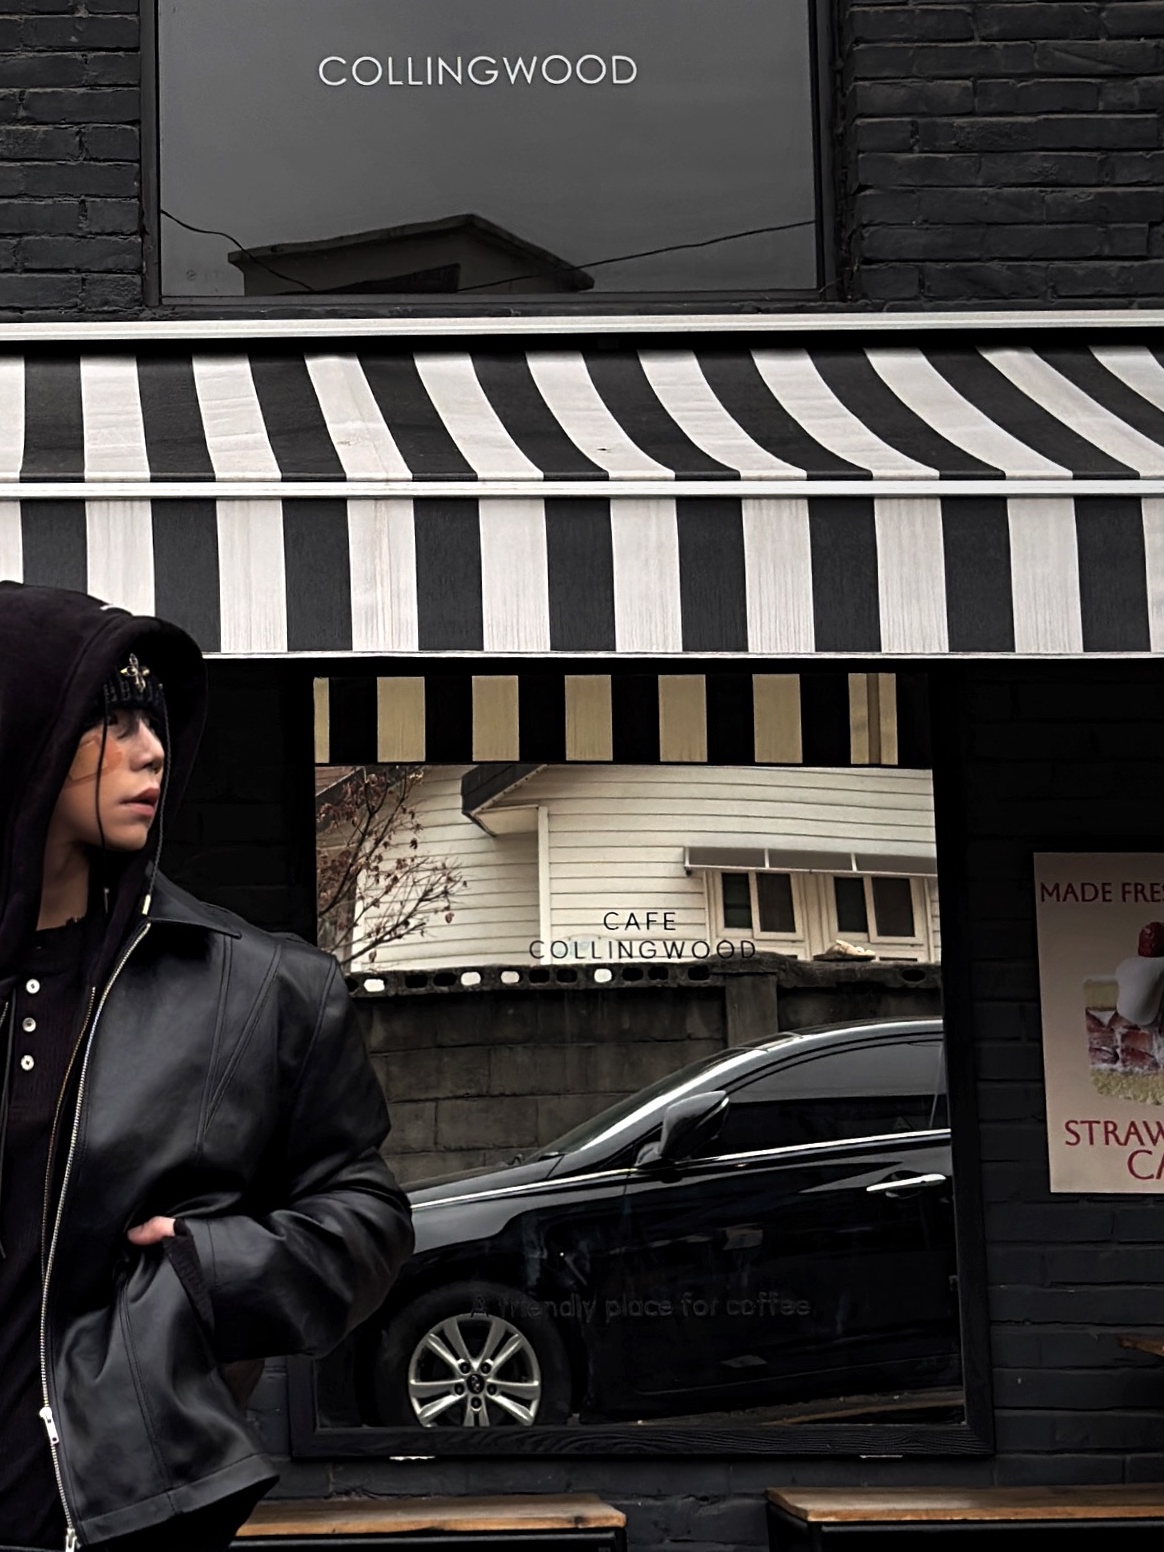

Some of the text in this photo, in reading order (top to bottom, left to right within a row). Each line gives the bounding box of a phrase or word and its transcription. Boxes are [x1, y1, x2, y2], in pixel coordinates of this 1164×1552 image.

[318, 54, 637, 86] COLLINGWOOD
[1040, 882, 1164, 902] MADE FRE
[602, 911, 677, 931] CAFE
[529, 939, 756, 960] COLLINGWOOD
[605, 1292, 673, 1324] place
[681, 1291, 718, 1317] for
